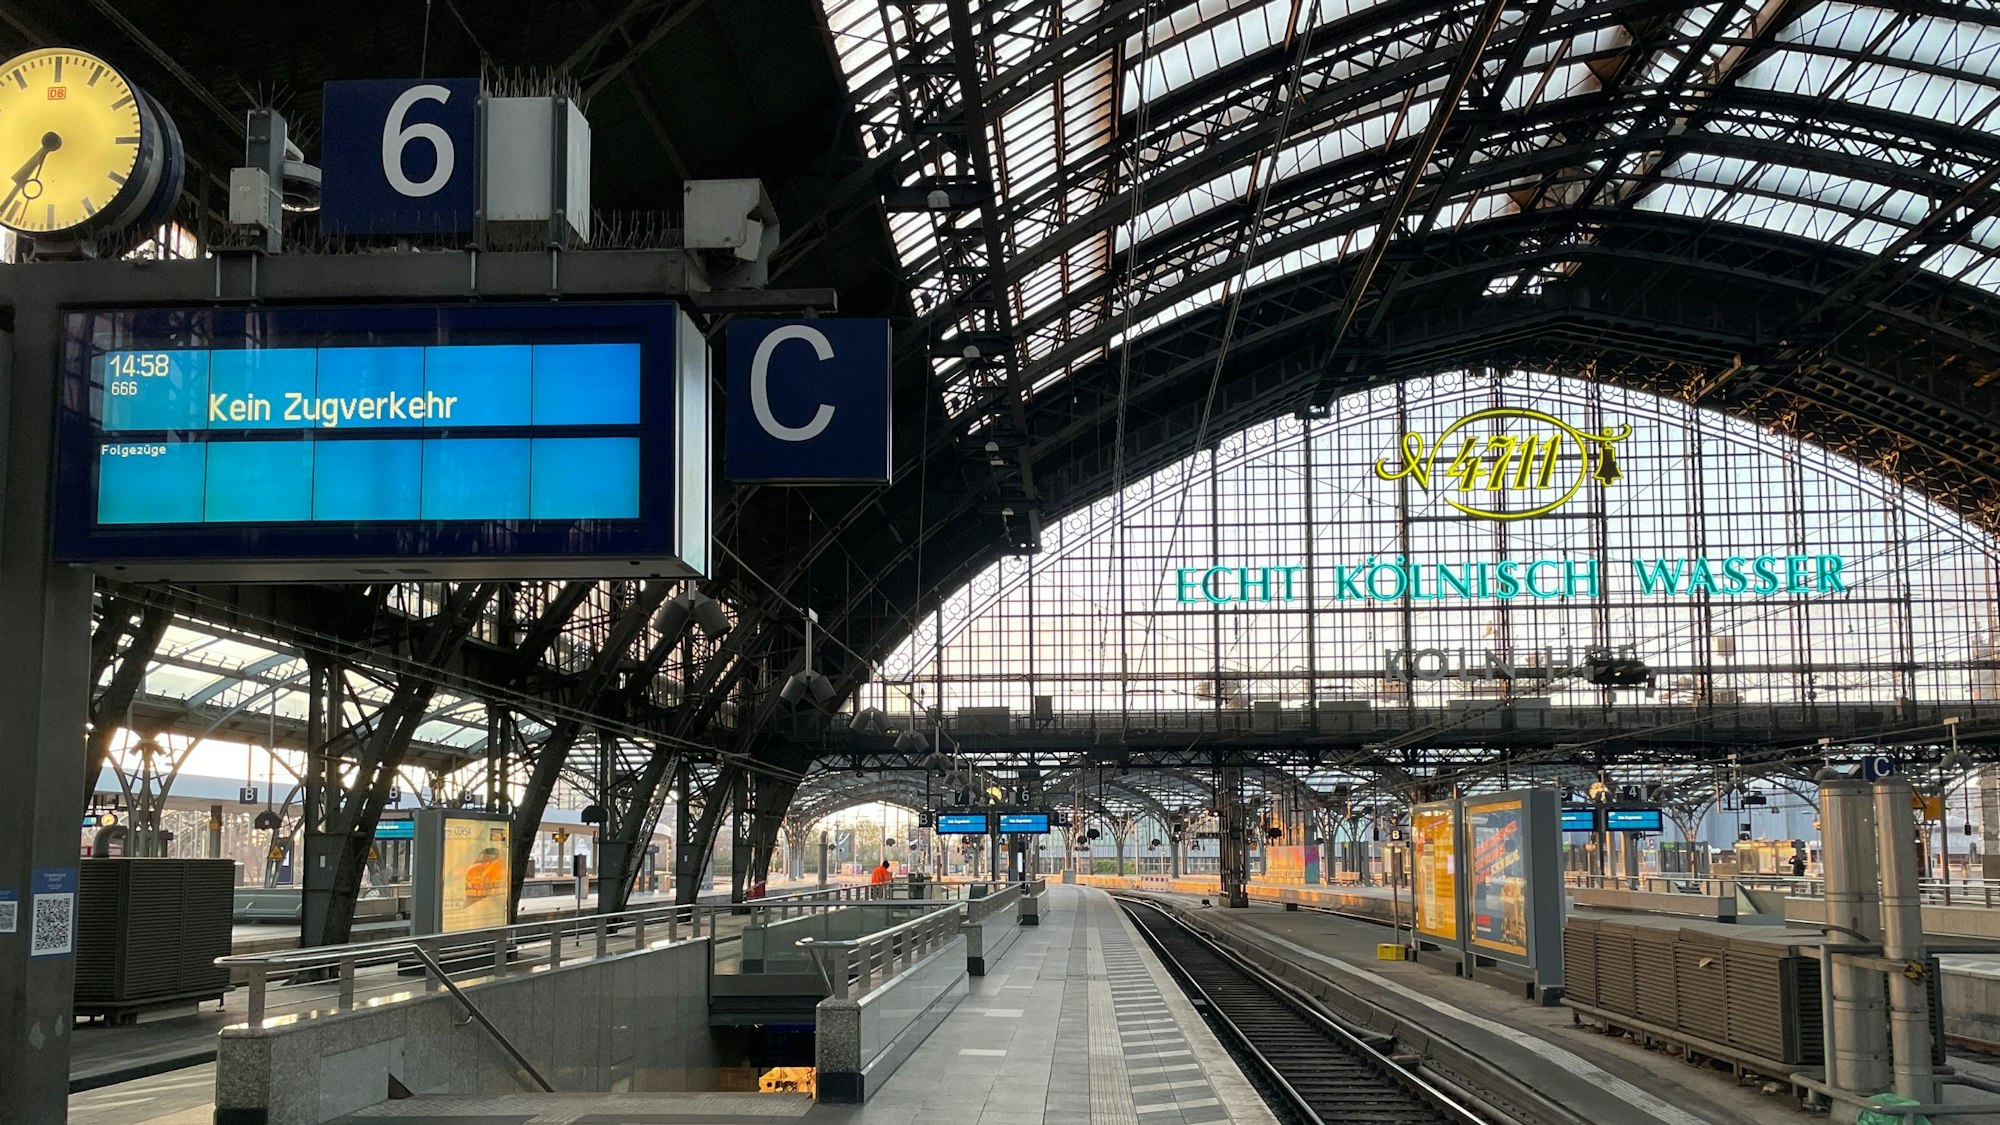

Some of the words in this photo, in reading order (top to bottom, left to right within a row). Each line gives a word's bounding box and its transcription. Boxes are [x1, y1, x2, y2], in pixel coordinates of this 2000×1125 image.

[49, 88, 65, 99] DB
[381, 84, 456, 198] 6
[109, 353, 169, 377] 14:58
[111, 381, 138, 396] 666
[749, 323, 836, 442] C
[209, 393, 271, 422] Kein
[284, 390, 458, 428] Zugverkehr
[101, 444, 167, 458] Folgezüge
[1445, 433, 1563, 492] 4711
[1176, 565, 1303, 604] ECHT
[1335, 554, 1600, 601] KÖLNISCH
[1632, 553, 1847, 596] WASSER
[1384, 645, 1516, 682] KÖLN
[1873, 756, 1890, 777] C
[245, 787, 255, 801] B
[389, 785, 398, 799] B
[464, 789, 472, 802] 8
[956, 791, 962, 802] 7
[1021, 790, 1030, 802] 6
[1628, 786, 1637, 797] 4
[920, 813, 928, 825] B
[1058, 812, 1067, 824] B
[1392, 830, 1400, 840] B
